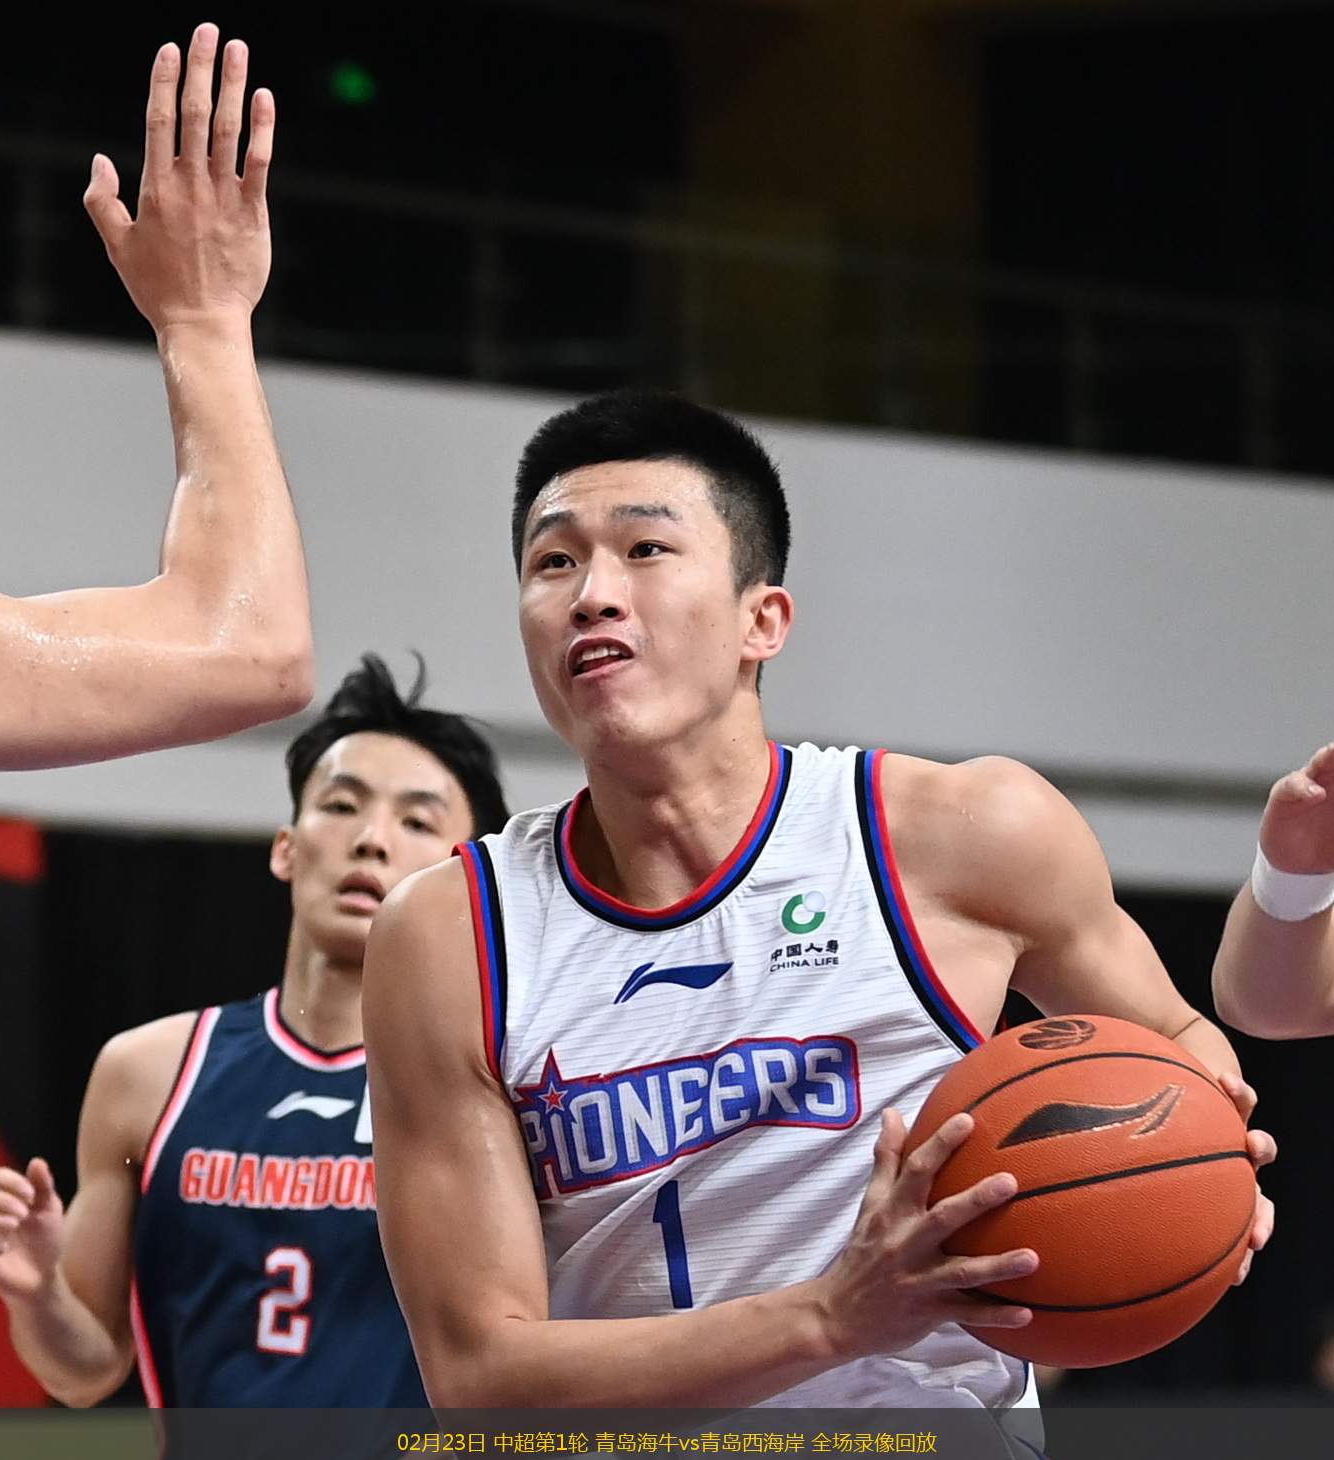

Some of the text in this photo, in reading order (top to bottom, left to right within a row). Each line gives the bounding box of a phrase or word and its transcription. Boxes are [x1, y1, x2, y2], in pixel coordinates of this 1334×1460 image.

[769, 956, 839, 973] CHINA LIFE
[653, 1180, 693, 1309] 1
[257, 1245, 314, 1356] 2
